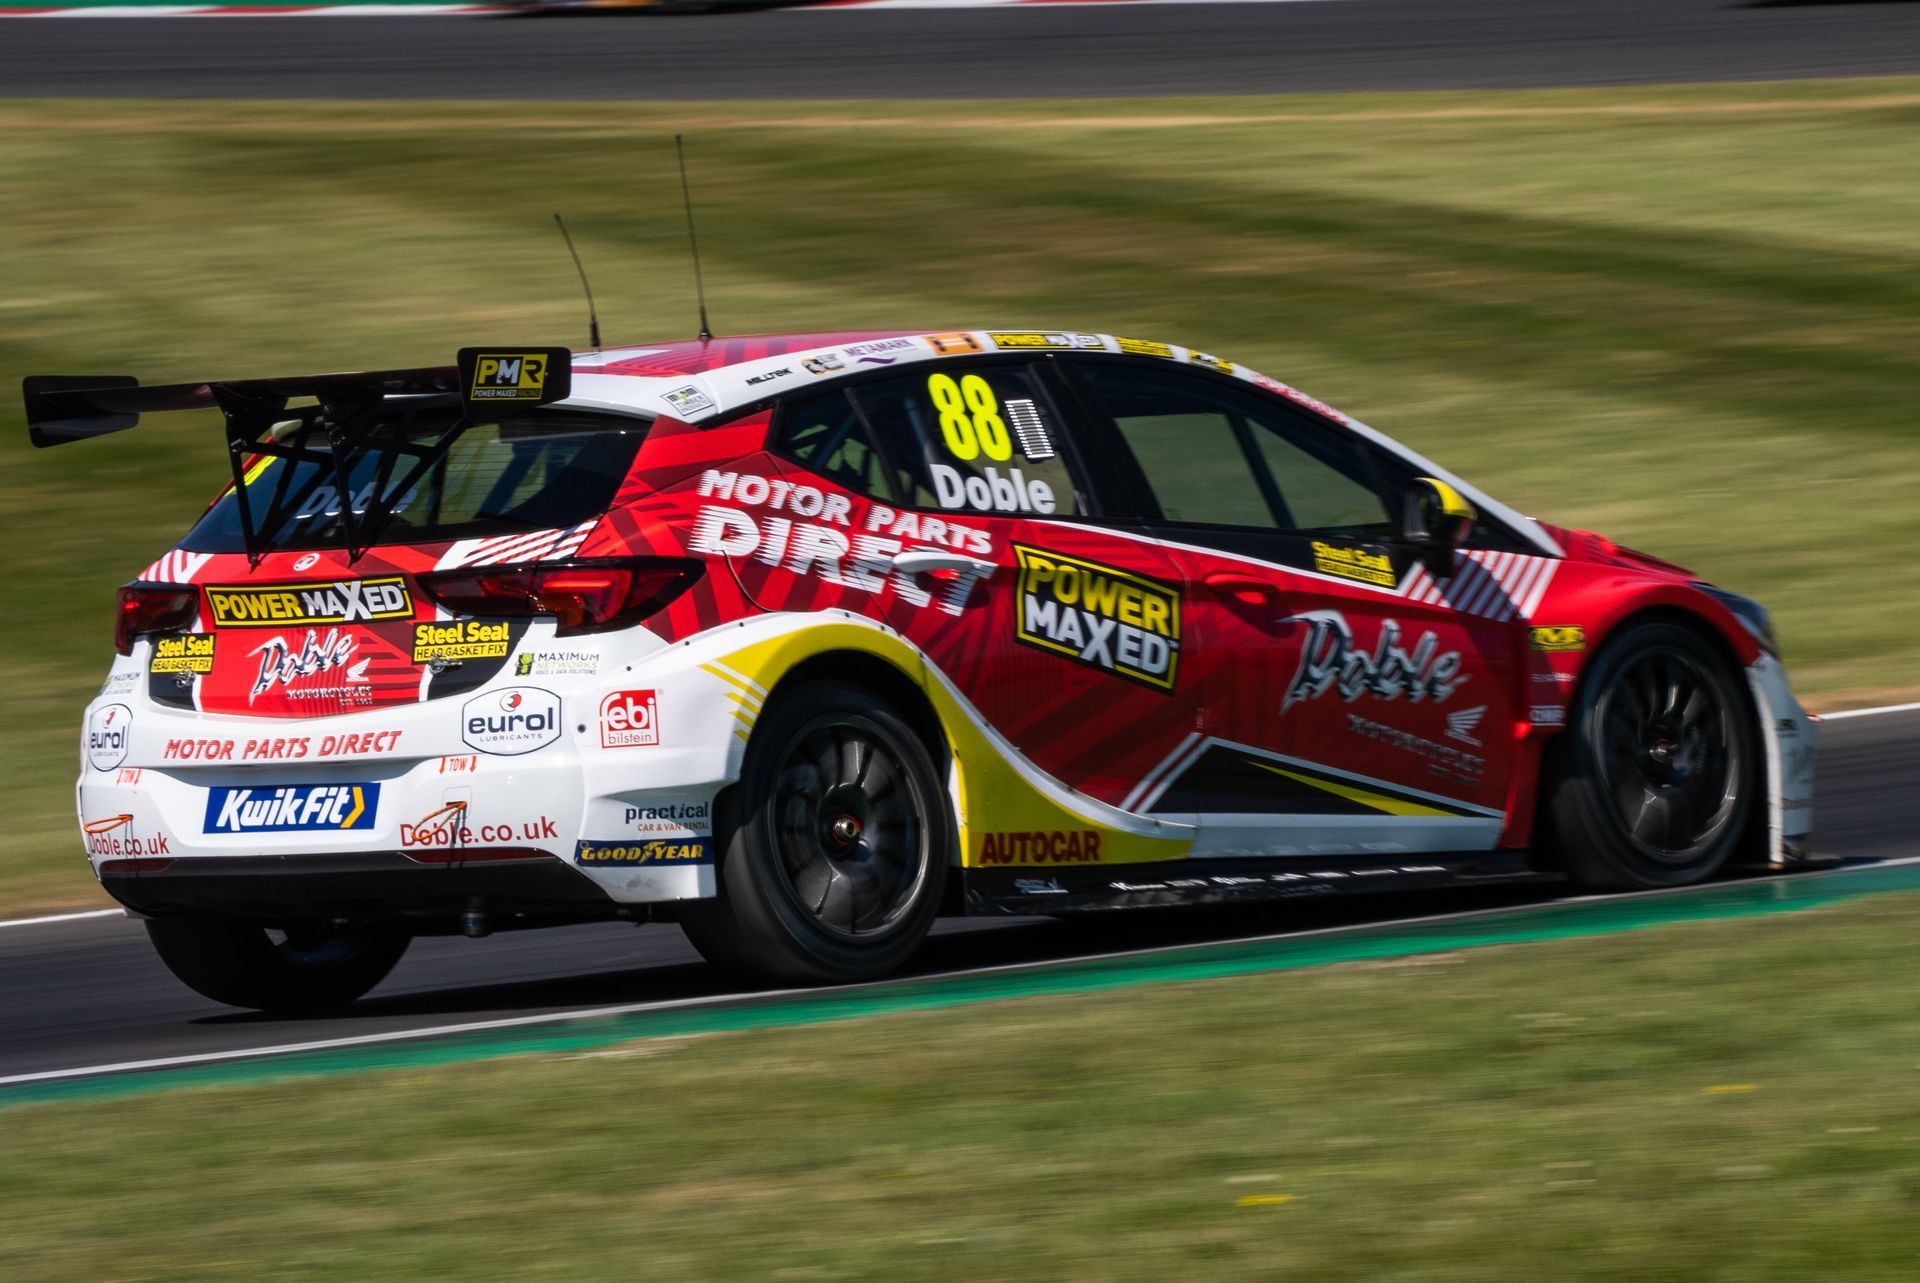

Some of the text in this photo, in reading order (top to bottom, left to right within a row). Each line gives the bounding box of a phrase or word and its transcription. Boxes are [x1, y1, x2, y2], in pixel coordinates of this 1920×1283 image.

[478, 359, 542, 384] PMR
[928, 373, 1012, 461] 88
[930, 464, 1056, 514] Doble
[697, 469, 993, 556] MOTOR PARTS
[212, 580, 404, 621] POWER MAXED
[1026, 554, 1171, 636] POWER
[415, 621, 509, 645] Steel Seal
[1024, 594, 1171, 669] MAXED
[156, 635, 214, 658] Steel Seal
[445, 645, 486, 657] GASKET
[488, 644, 509, 654] FIX
[538, 652, 600, 662] MAXIMUM
[245, 628, 360, 706] Doble
[536, 662, 598, 670] NETWORKS
[1274, 610, 1472, 715] Doble
[468, 708, 553, 734] eurol
[600, 692, 656, 730] febi
[90, 726, 126, 749] eurol
[163, 730, 402, 760] MOTOR PARTS DIRECT
[480, 732, 543, 742] LUBRICANTS
[608, 732, 652, 744] bilstein
[450, 757, 467, 771] TOW
[625, 801, 708, 824] practical
[400, 815, 558, 847] Doble.co.uk
[638, 823, 654, 831] CAR
[656, 823, 662, 831] &
[664, 822, 681, 831] VAN
[88, 831, 170, 855] Doble.co.uk
[581, 841, 704, 862] GOODYEAR
[980, 831, 1100, 864] AUTOCAR
